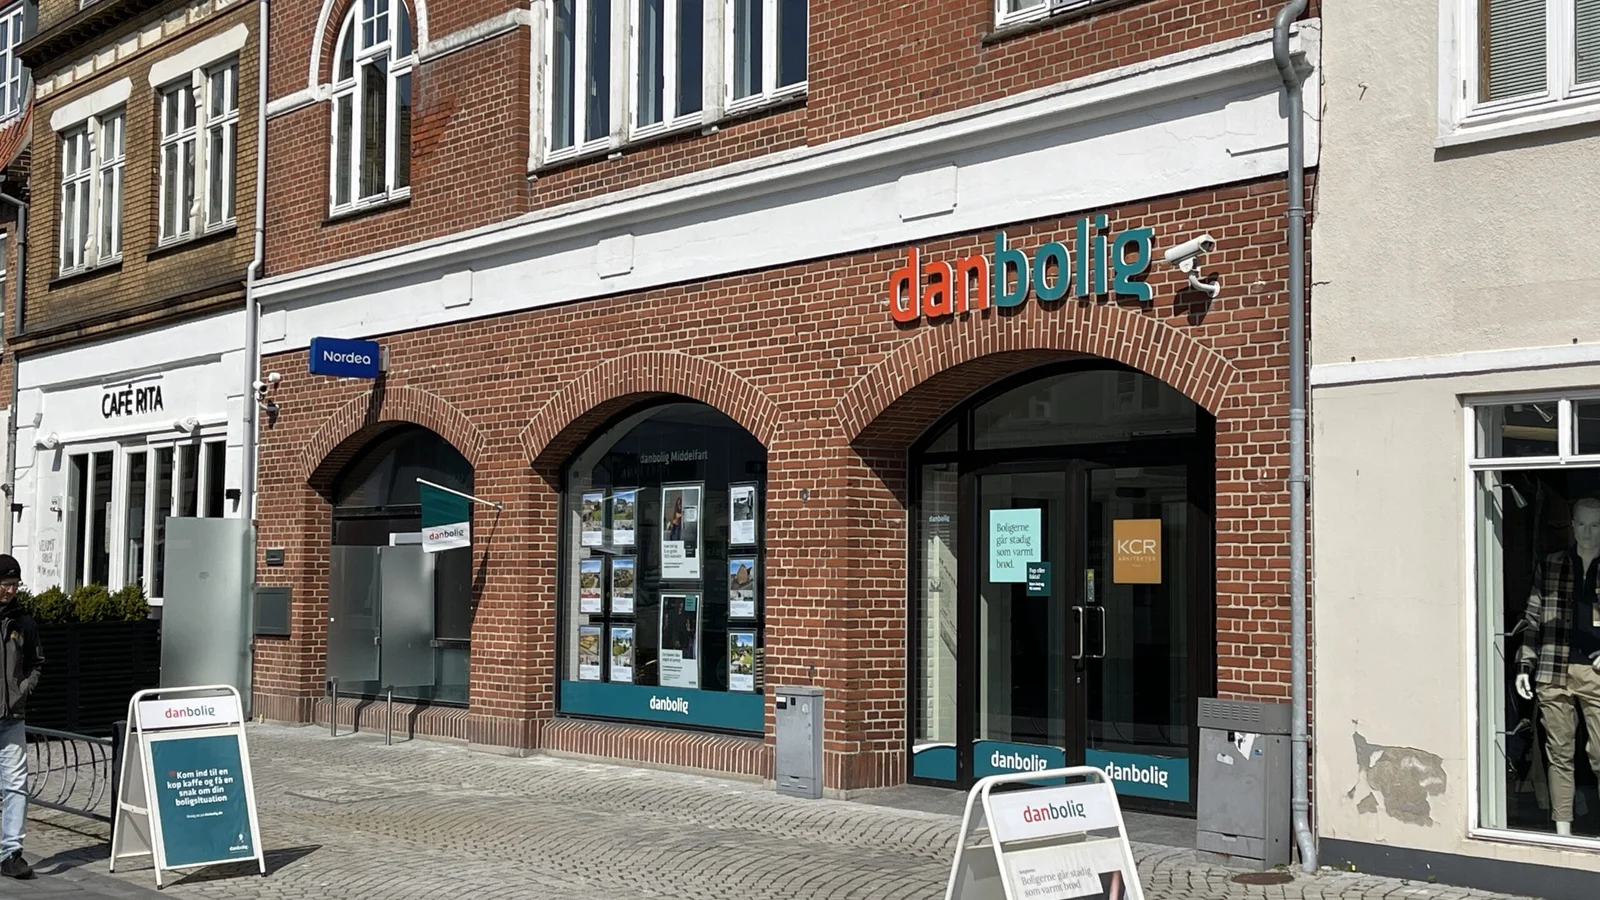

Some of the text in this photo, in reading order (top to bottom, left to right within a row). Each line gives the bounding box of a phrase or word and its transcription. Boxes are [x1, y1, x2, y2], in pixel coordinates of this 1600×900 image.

[889, 214, 1155, 322] danbolig
[323, 350, 371, 365] Nordea
[102, 383, 163, 419] CAFÉ RITA
[640, 449, 709, 465] danbolig Middelfart
[429, 529, 464, 540] danbolig
[996, 523, 1029, 534] Boligerne
[996, 535, 1031, 547] går stadig
[1117, 539, 1157, 555] KCR
[165, 705, 216, 719] danbolig
[649, 694, 689, 715] danbolig
[991, 751, 1048, 772] danbolig
[176, 771, 195, 779] Kom
[195, 769, 208, 777] ind
[209, 768, 218, 776] til
[1105, 762, 1169, 788] danbolig
[167, 781, 182, 790] kop
[182, 779, 203, 788] kaffe
[203, 779, 214, 787] og
[179, 788, 197, 797] snak
[175, 795, 228, 806] boligsituation
[1023, 800, 1087, 823] danbolig
[1021, 867, 1092, 886] Boligerne går stadig
[1024, 879, 1081, 897] som varmt brød
